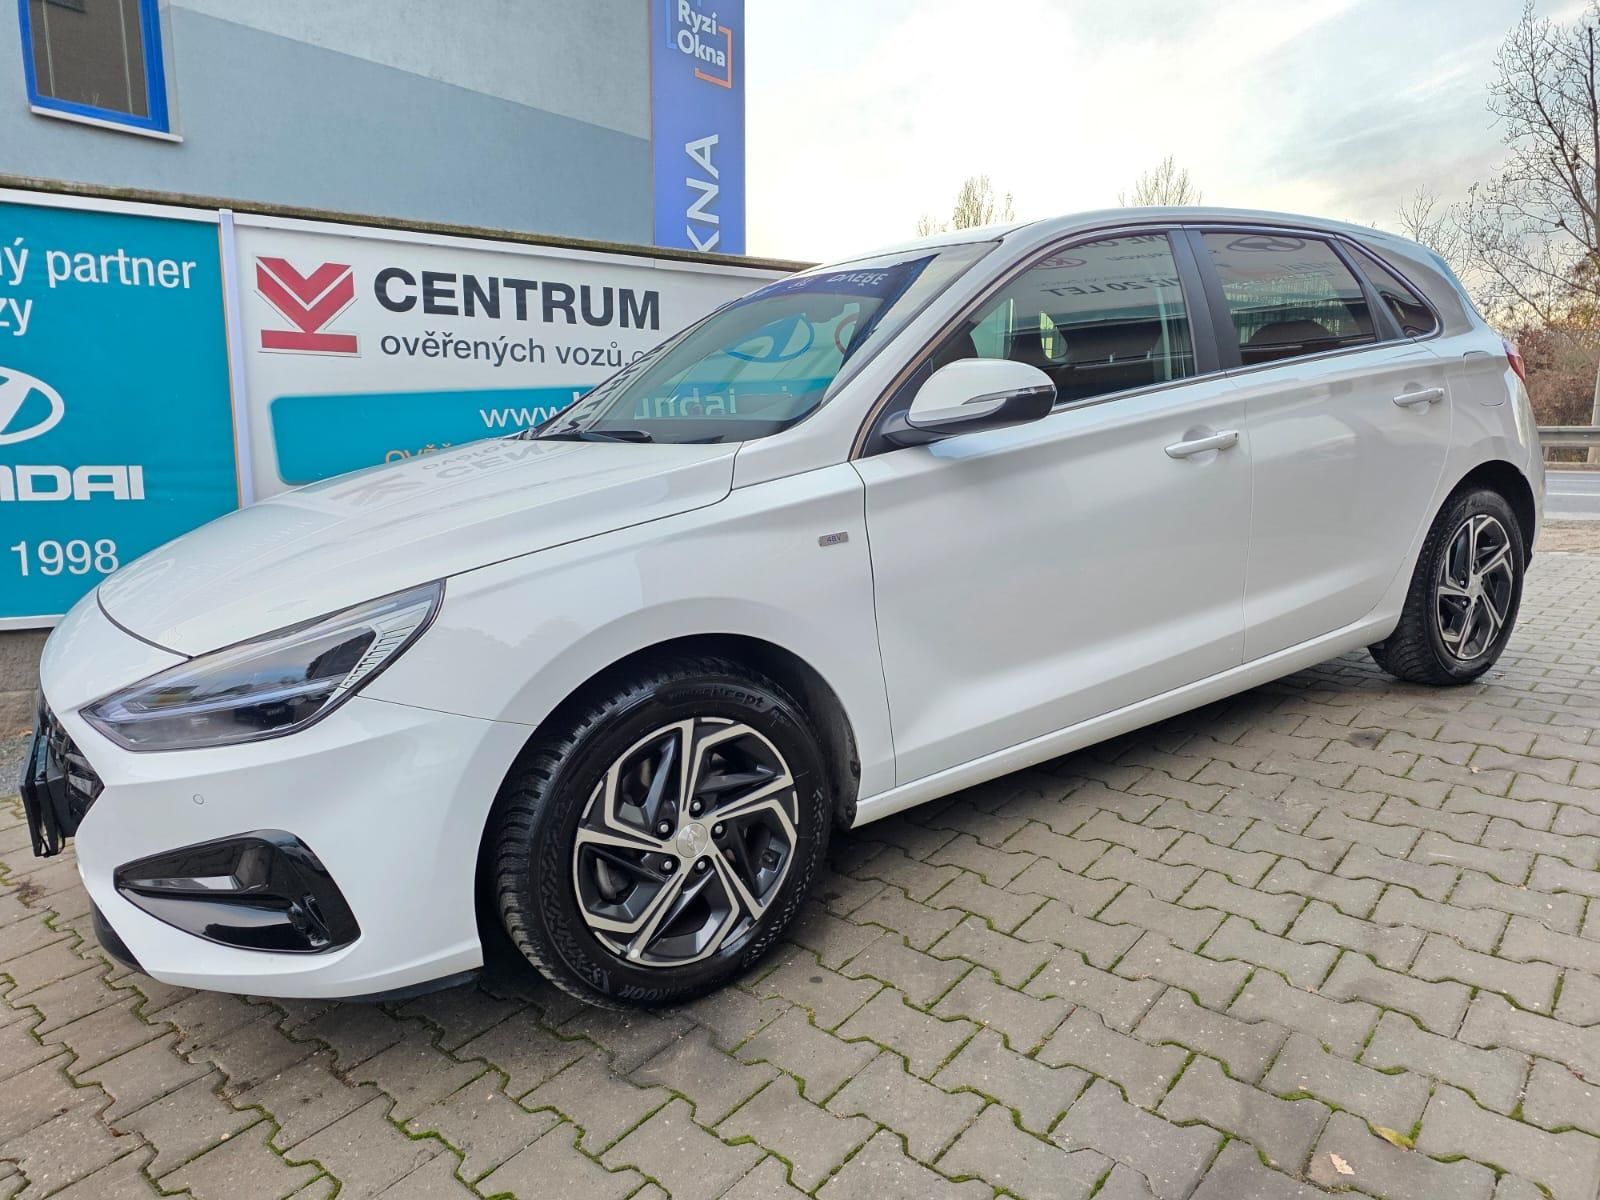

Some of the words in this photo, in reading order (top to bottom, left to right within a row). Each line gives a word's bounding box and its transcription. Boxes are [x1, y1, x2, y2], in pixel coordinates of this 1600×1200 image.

[677, 29, 726, 67] Okna
[0, 237, 29, 286] ý
[46, 248, 197, 289] partner
[374, 267, 660, 331] CENTRUM
[380, 331, 545, 367] ověřených
[10, 538, 119, 577] 1998
